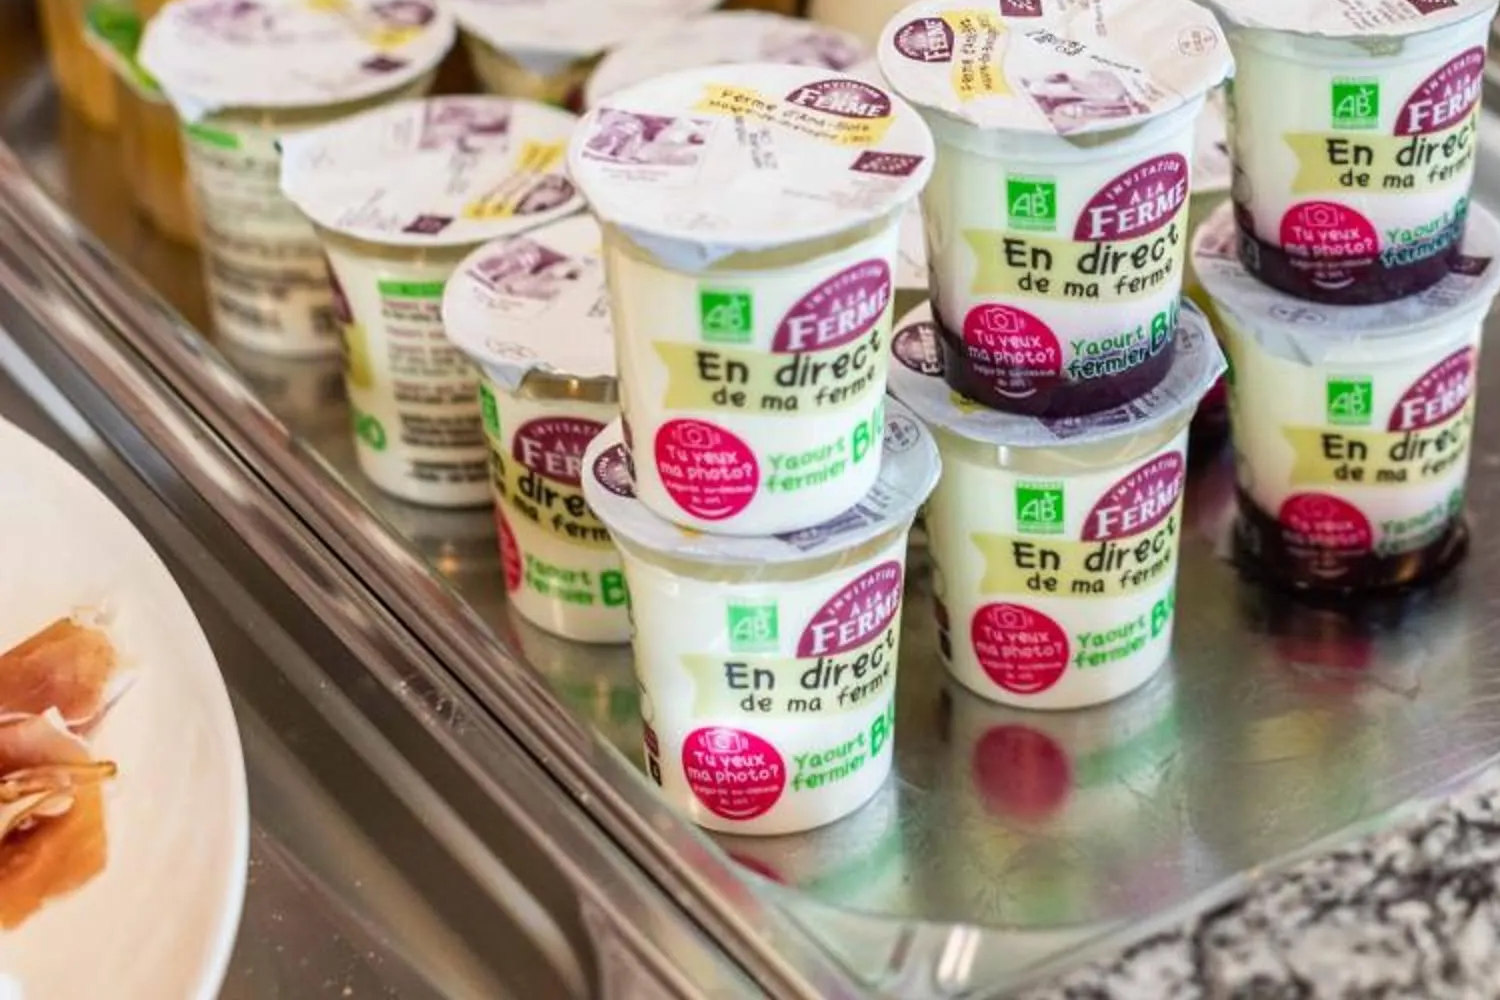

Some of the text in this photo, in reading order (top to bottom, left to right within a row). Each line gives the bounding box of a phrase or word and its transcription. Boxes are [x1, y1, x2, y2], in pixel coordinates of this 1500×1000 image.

[1326, 138, 1374, 167] En
[1339, 168, 1370, 187] de
[1382, 174, 1415, 189] ma
[1088, 178, 1185, 239] FERME
[1293, 227, 1360, 244] Tu veux
[1312, 238, 1373, 257] photo?
[1003, 223, 1179, 276] En direct
[1019, 272, 1049, 293] de
[1064, 281, 1099, 298] ma
[787, 282, 888, 349] FERME
[973, 329, 1041, 348] Tu veux
[1070, 327, 1143, 356] Yaourt
[696, 330, 880, 388] En direct
[968, 346, 1056, 366] ma photo?
[1067, 346, 1151, 380] fermier
[711, 386, 746, 408] de
[761, 394, 798, 410] ma
[521, 437, 581, 476] FER
[666, 446, 738, 466] Tu veux
[768, 438, 844, 470] Yaourt
[1321, 434, 1367, 461] En
[660, 462, 752, 481] ma photo?
[766, 459, 847, 494] fermier
[1333, 463, 1364, 482] de
[1376, 468, 1408, 483] ma
[552, 512, 611, 542] ferm
[1012, 516, 1176, 572] En direct
[1026, 571, 1058, 593] de
[1071, 579, 1105, 593] ma
[982, 625, 1050, 644] Tu veux
[1076, 615, 1146, 649] Yaourt
[724, 628, 894, 690] En direct
[1002, 641, 1063, 659] photo?
[740, 694, 772, 712] de
[788, 697, 821, 711] ma
[693, 752, 766, 768] Tu veux
[792, 732, 865, 770] Yaourt
[688, 765, 779, 784] ma photo?
[792, 754, 867, 792] fermier
